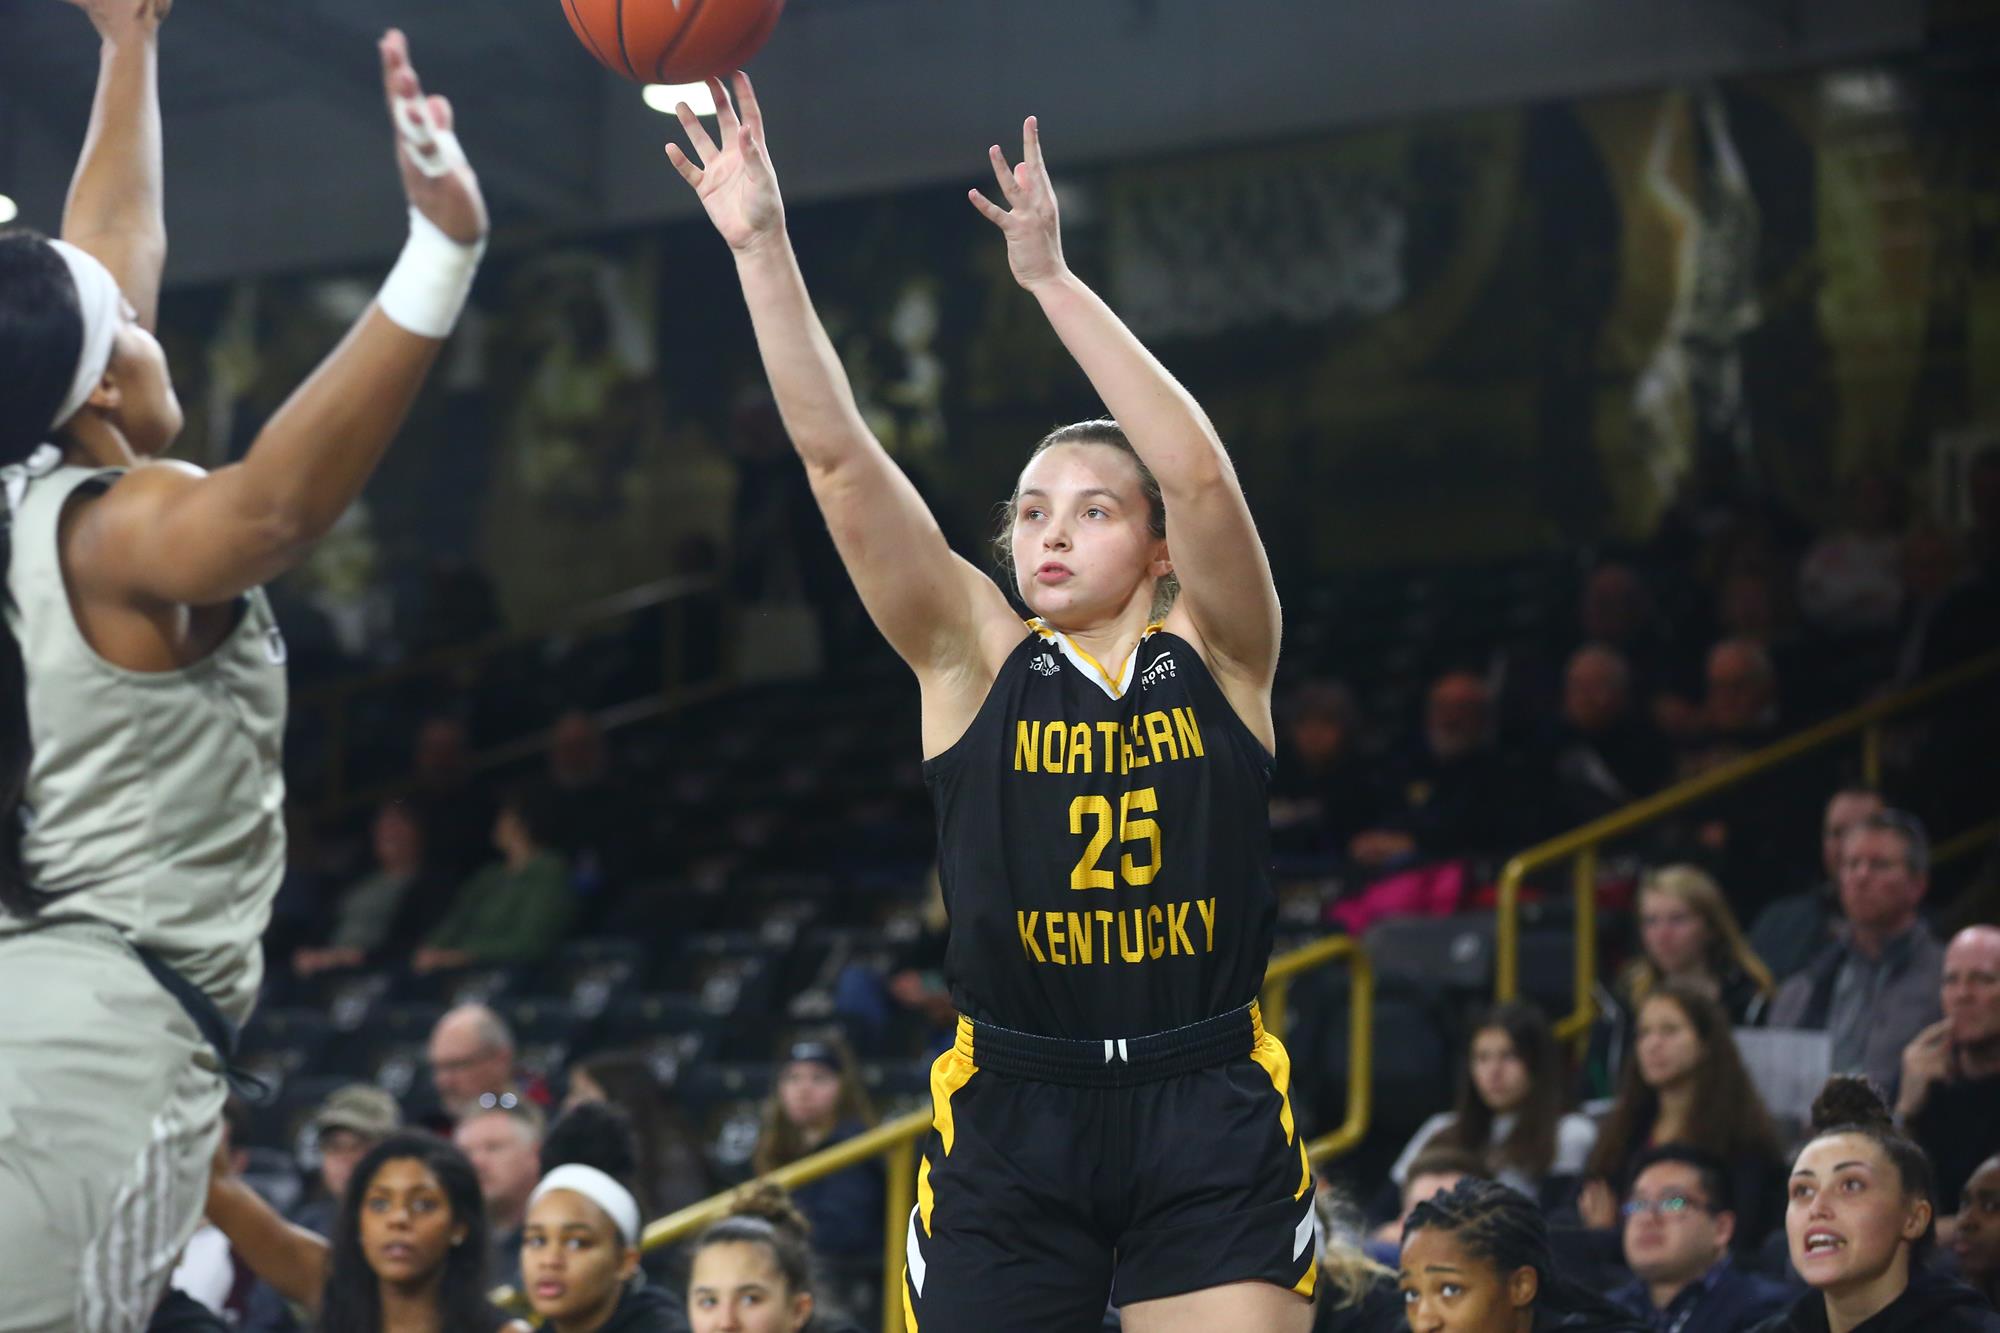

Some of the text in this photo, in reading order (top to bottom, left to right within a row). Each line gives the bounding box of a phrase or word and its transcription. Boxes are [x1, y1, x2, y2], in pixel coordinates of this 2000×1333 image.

[1014, 706, 1205, 776] NORTHERN
[1069, 787, 1162, 890] 25
[1017, 897, 1216, 966] KENTUCKY
